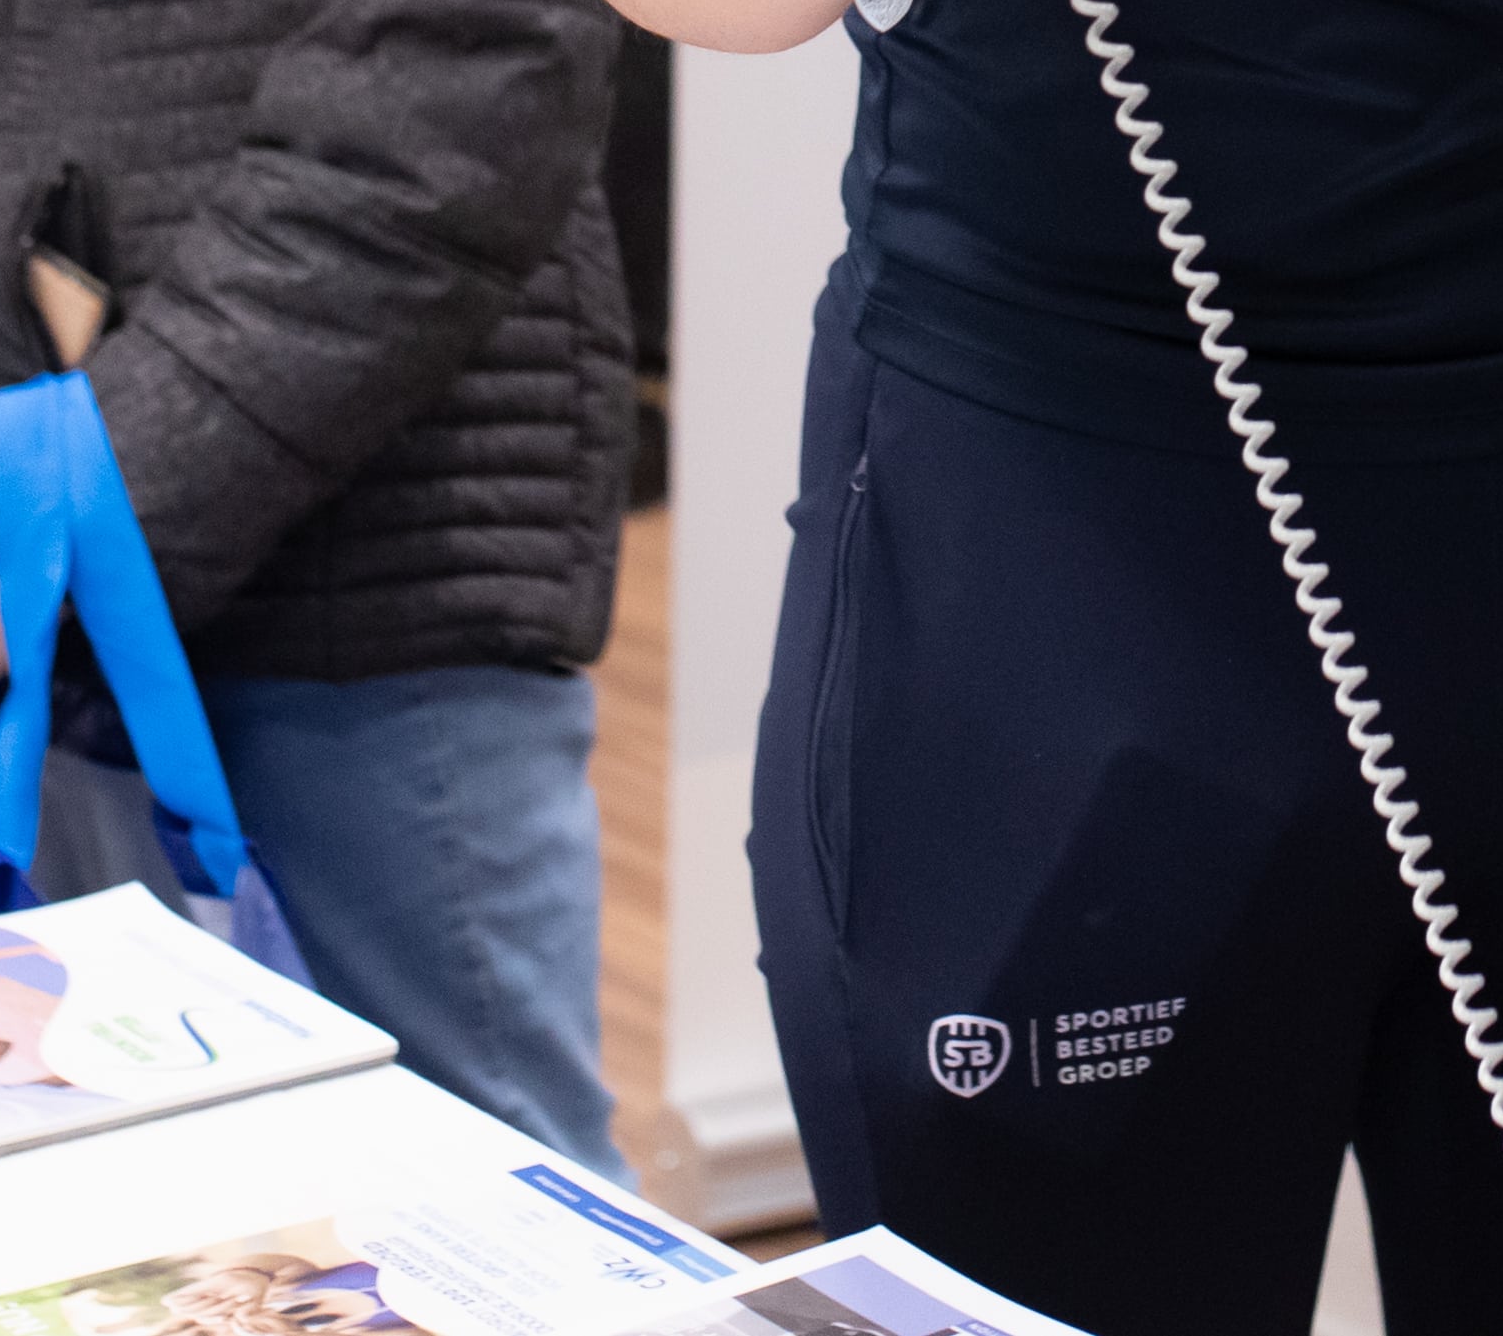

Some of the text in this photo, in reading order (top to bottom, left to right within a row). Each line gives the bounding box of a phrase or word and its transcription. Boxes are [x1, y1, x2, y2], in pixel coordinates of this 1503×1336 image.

[1055, 997, 1187, 1033] SPORTIEF
[942, 1040, 994, 1067] SB
[1055, 1026, 1174, 1059] BESTEED
[1057, 1056, 1151, 1084] GROEP
